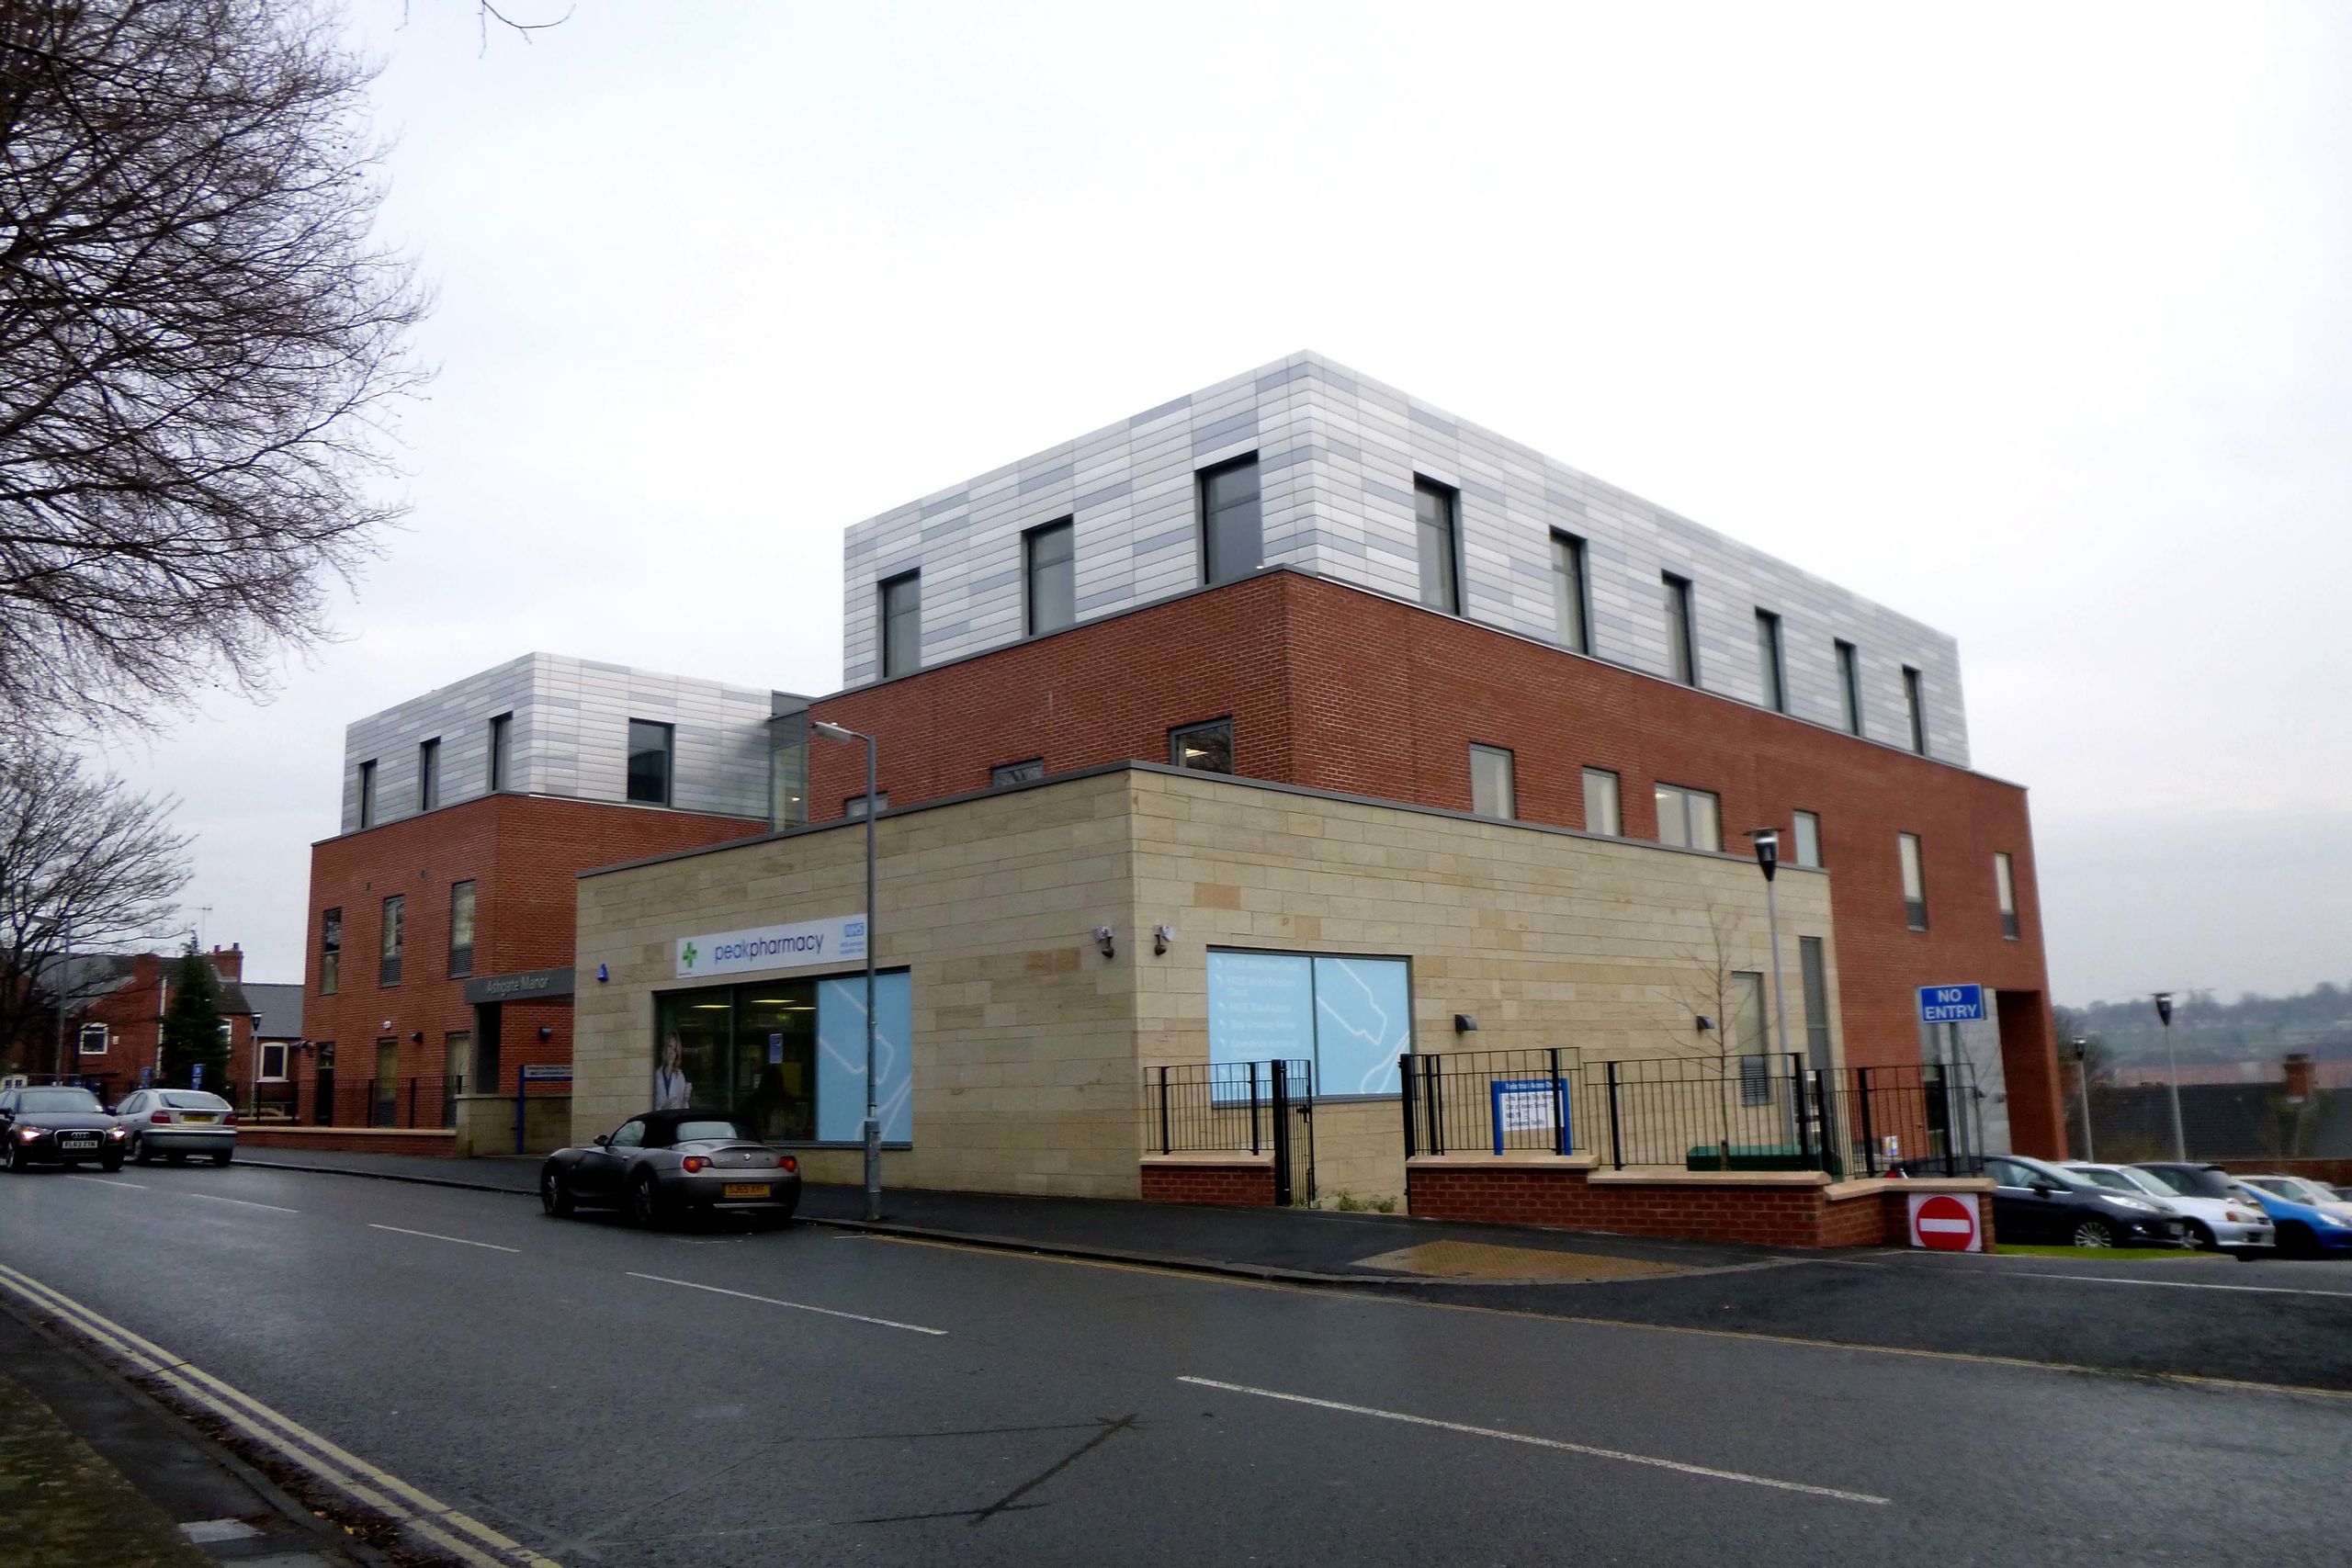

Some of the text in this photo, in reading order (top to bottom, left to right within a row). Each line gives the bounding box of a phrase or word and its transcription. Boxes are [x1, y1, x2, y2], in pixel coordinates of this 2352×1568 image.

[715, 933, 823, 964] peakpharmacy
[485, 976, 548, 997] Ashgate Manor
[1938, 988, 1962, 1002] NO
[1925, 1004, 1977, 1020] ENTRY
